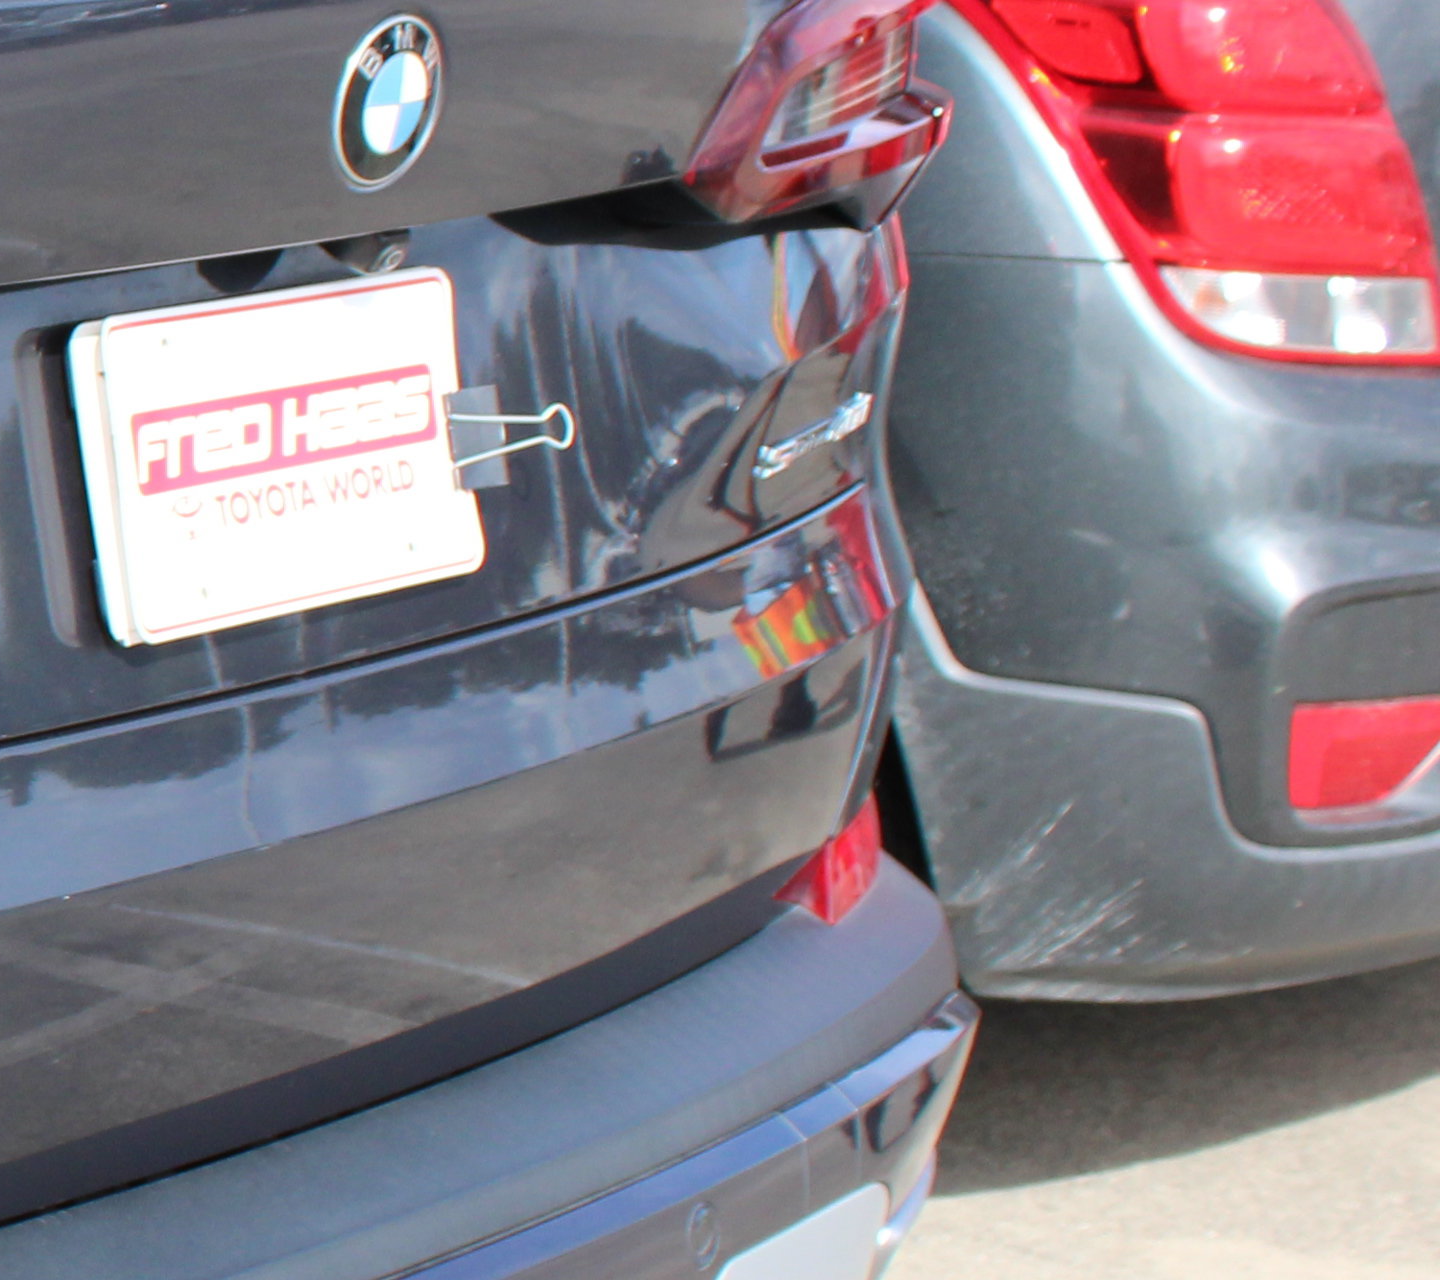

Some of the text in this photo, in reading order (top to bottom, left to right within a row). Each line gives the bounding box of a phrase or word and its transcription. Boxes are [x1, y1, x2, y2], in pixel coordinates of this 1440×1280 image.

[358, 22, 438, 80] BMW
[215, 460, 415, 525] TOYOTA WORLD
